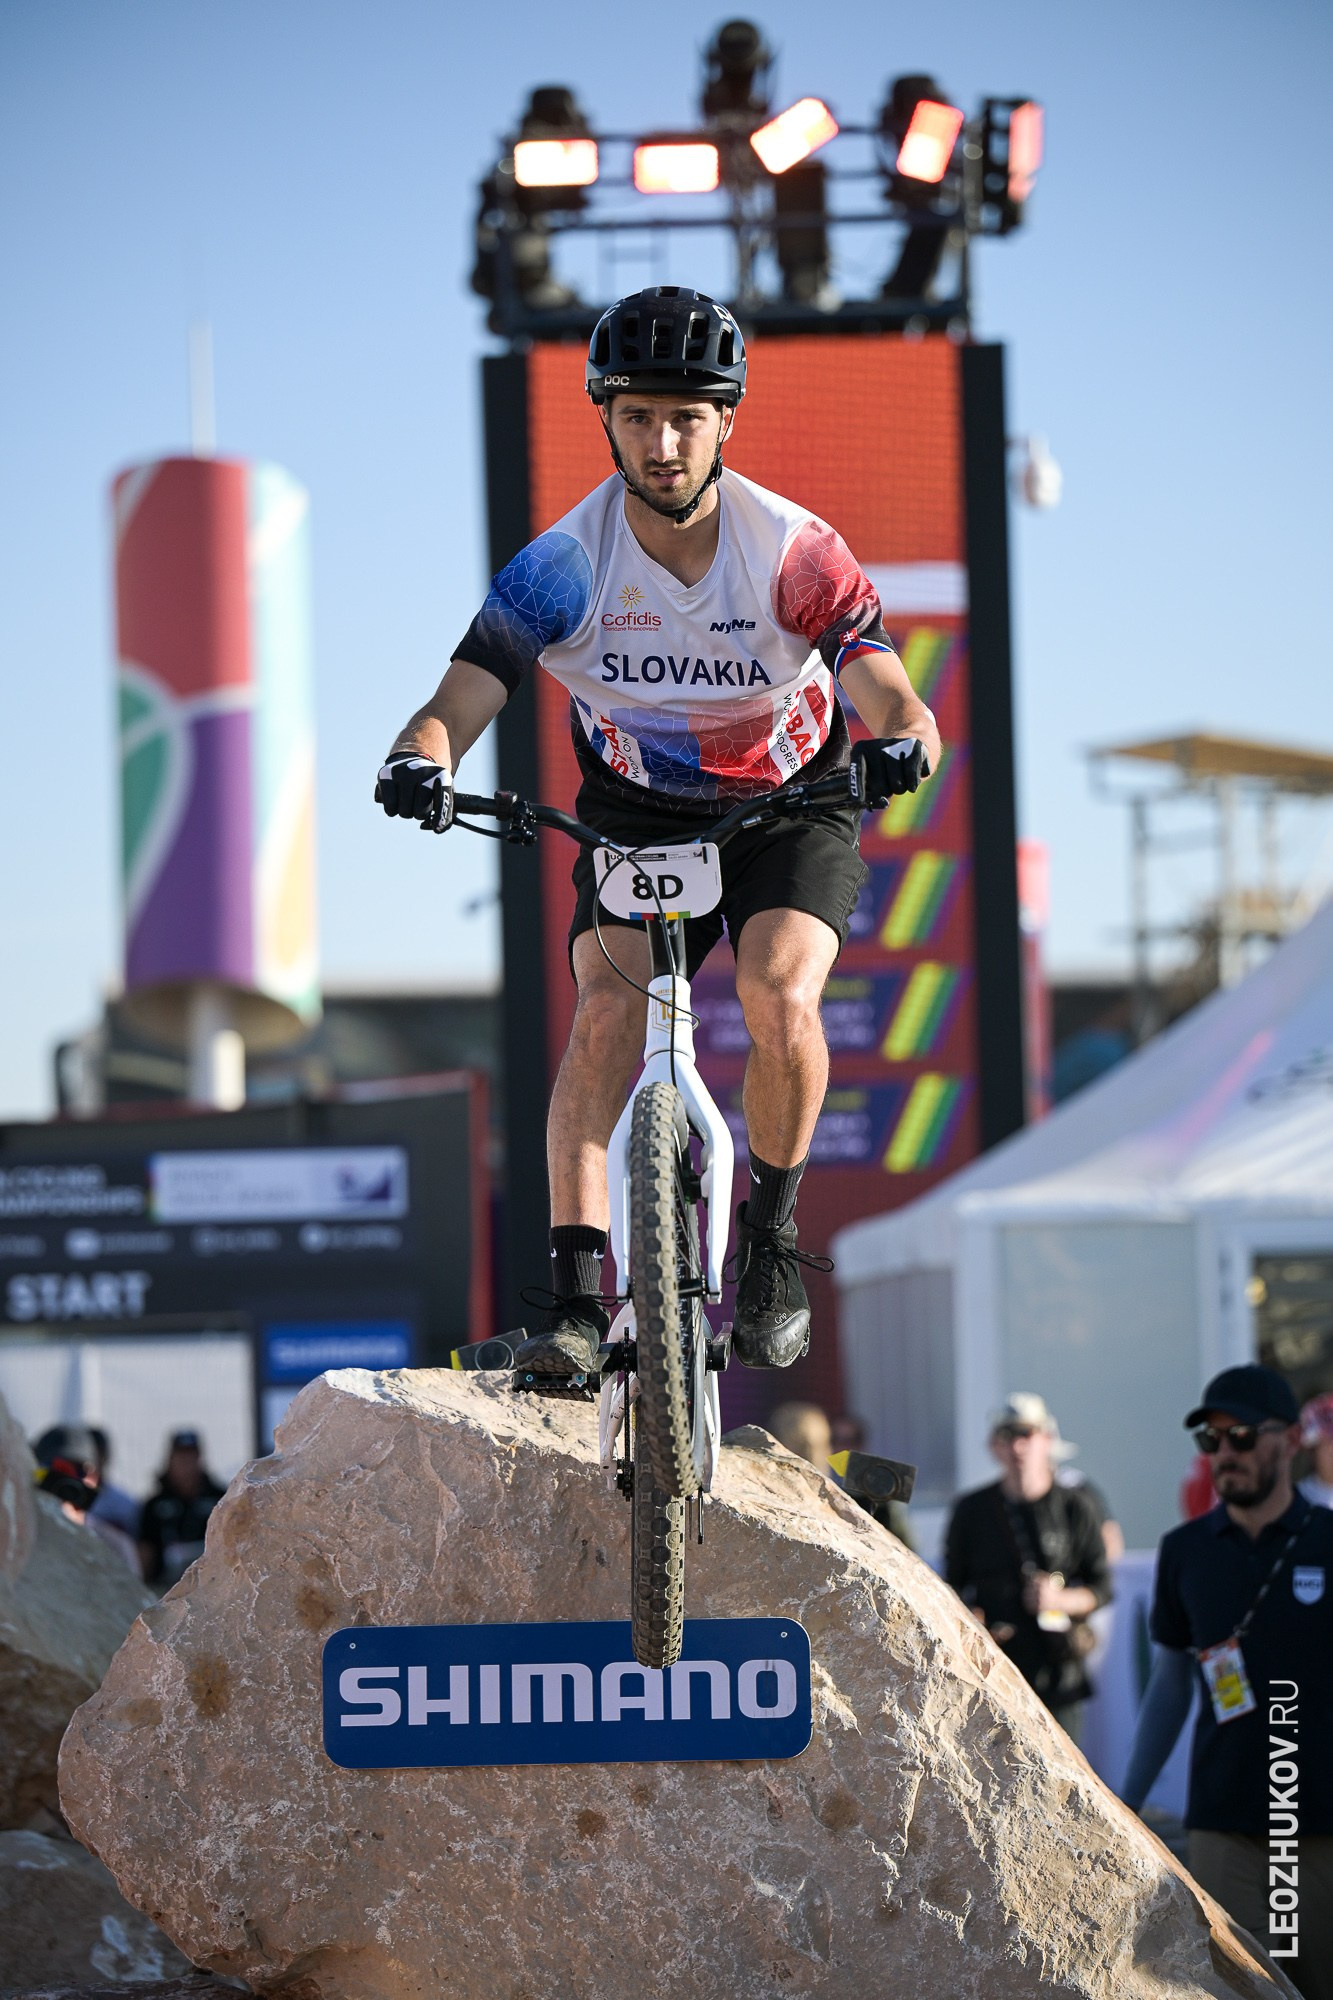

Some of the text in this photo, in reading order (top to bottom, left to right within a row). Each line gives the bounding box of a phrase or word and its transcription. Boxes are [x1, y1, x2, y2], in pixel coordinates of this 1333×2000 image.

[604, 375, 630, 386] POC
[601, 611, 662, 626] Cofidis
[601, 652, 772, 687] SLOVAKIA
[632, 874, 684, 900] 8D
[7, 1272, 150, 1321] START
[339, 1659, 797, 1727] SHIMANO
